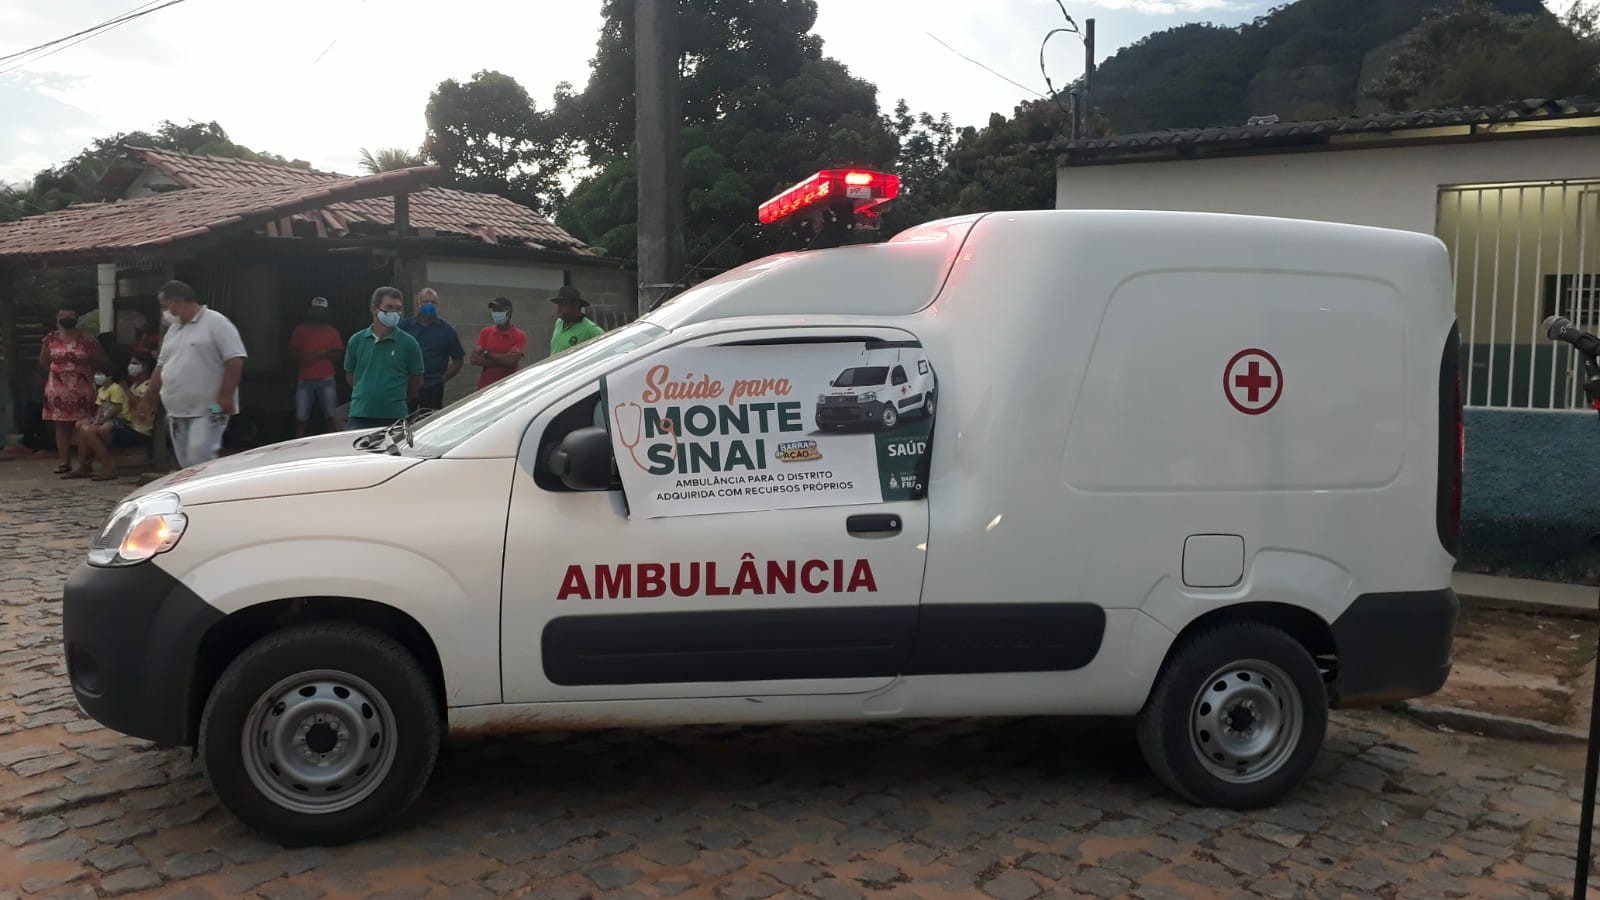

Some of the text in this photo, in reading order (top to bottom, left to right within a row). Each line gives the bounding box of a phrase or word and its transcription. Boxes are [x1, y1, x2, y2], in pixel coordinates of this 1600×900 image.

[641, 364, 793, 406] Saúde para
[643, 400, 802, 439] MONTE
[647, 439, 767, 476] SINAI
[780, 441, 809, 451] BARRA
[656, 481, 854, 501] ADQUIRIDA COM RECURSOS PRÓPRIOS
[675, 470, 833, 488] AMBULÂNCIA PARA O DISTRITO
[556, 552, 878, 600] AMBULÂNCIA
